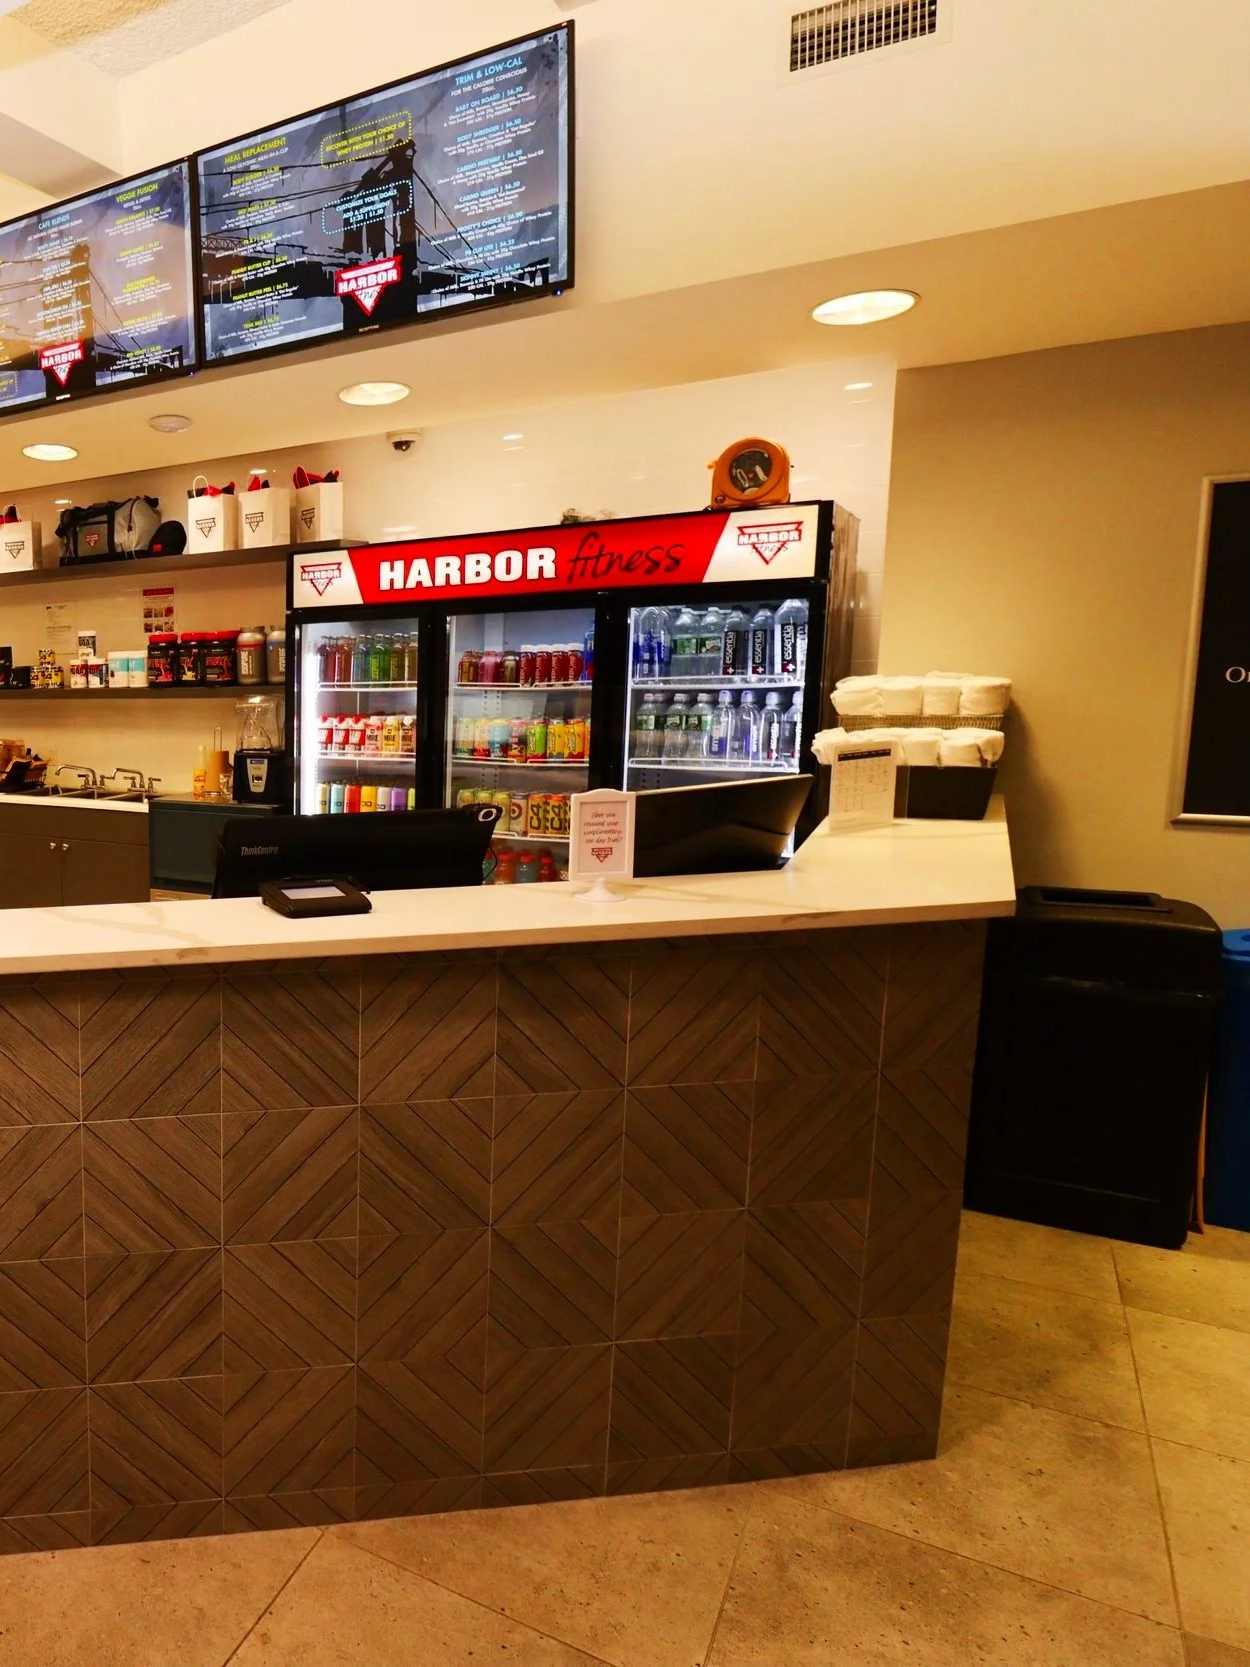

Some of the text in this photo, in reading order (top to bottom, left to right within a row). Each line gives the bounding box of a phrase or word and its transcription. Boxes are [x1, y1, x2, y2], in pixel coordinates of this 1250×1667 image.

[451, 89, 461, 97] FOR
[462, 85, 472, 93] THE
[496, 67, 527, 82] CONSCIOUS
[455, 56, 522, 87] TRIM & LOW-CAL
[224, 137, 286, 165] MEAL REPLACEMENT
[457, 163, 476, 173] CARDIO
[116, 183, 158, 204] VEGGIE FUSION
[459, 192, 479, 203] CARDIO
[38, 220, 50, 231] CAFE
[338, 268, 398, 294] HARBOR
[41, 350, 82, 369] HARBOR
[739, 531, 797, 545] HARBOR
[379, 531, 686, 591] HARBOR fitness
[302, 569, 340, 581] HARBOR
[725, 631, 734, 664] essentia
[754, 630, 763, 664] essentia
[784, 625, 794, 660] essentia
[1225, 666, 1250, 683] O
[530, 802, 542, 830] C4
